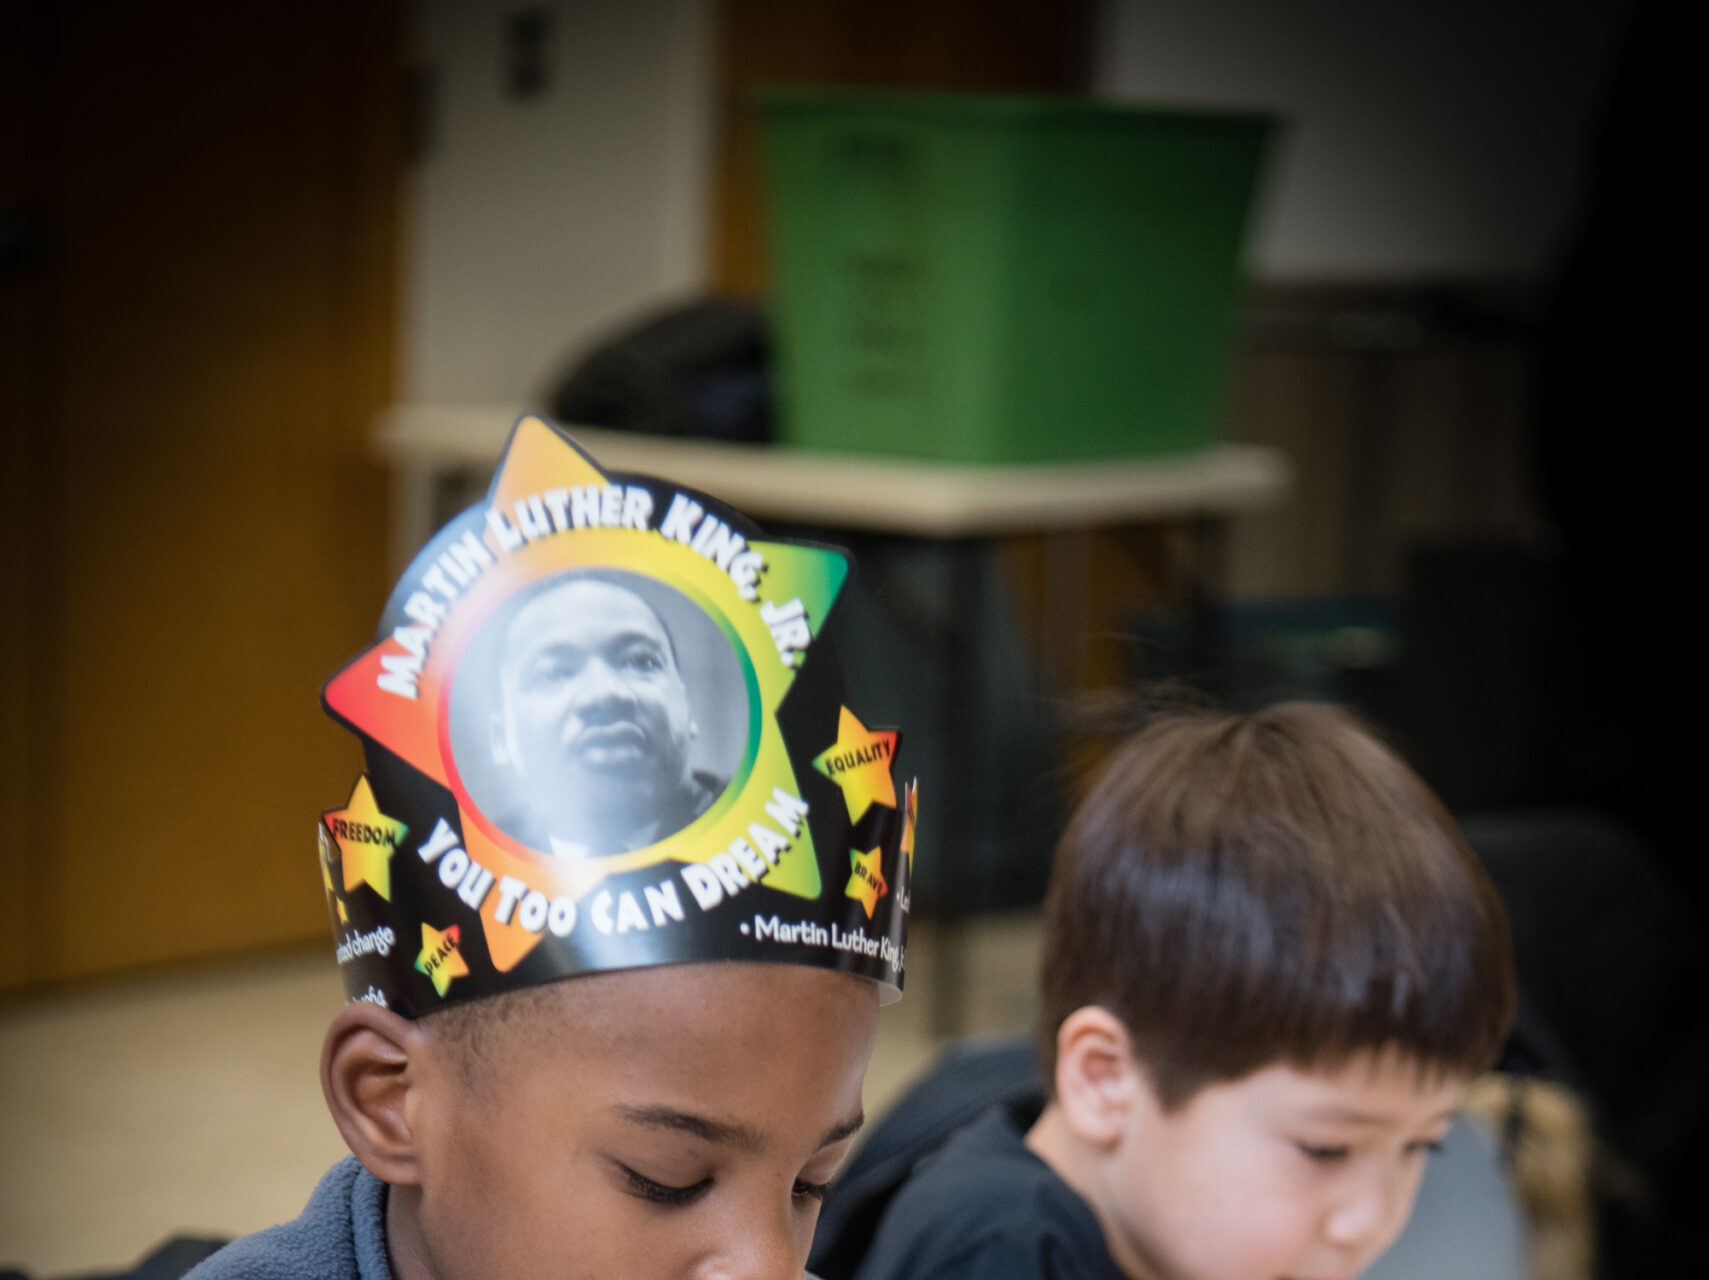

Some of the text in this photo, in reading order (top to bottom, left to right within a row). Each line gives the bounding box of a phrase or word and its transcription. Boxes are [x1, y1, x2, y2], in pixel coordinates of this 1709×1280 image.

[377, 484, 815, 700] MARTIN LUTHER KING, JR.
[825, 739, 892, 778] EQUALITY
[333, 818, 396, 847] FREEDOM
[417, 787, 809, 936] YOU TOO CAN DREAM
[352, 919, 396, 957] change
[424, 932, 461, 976] PEACE
[755, 916, 829, 946] Martin
[831, 921, 880, 958] Luther
